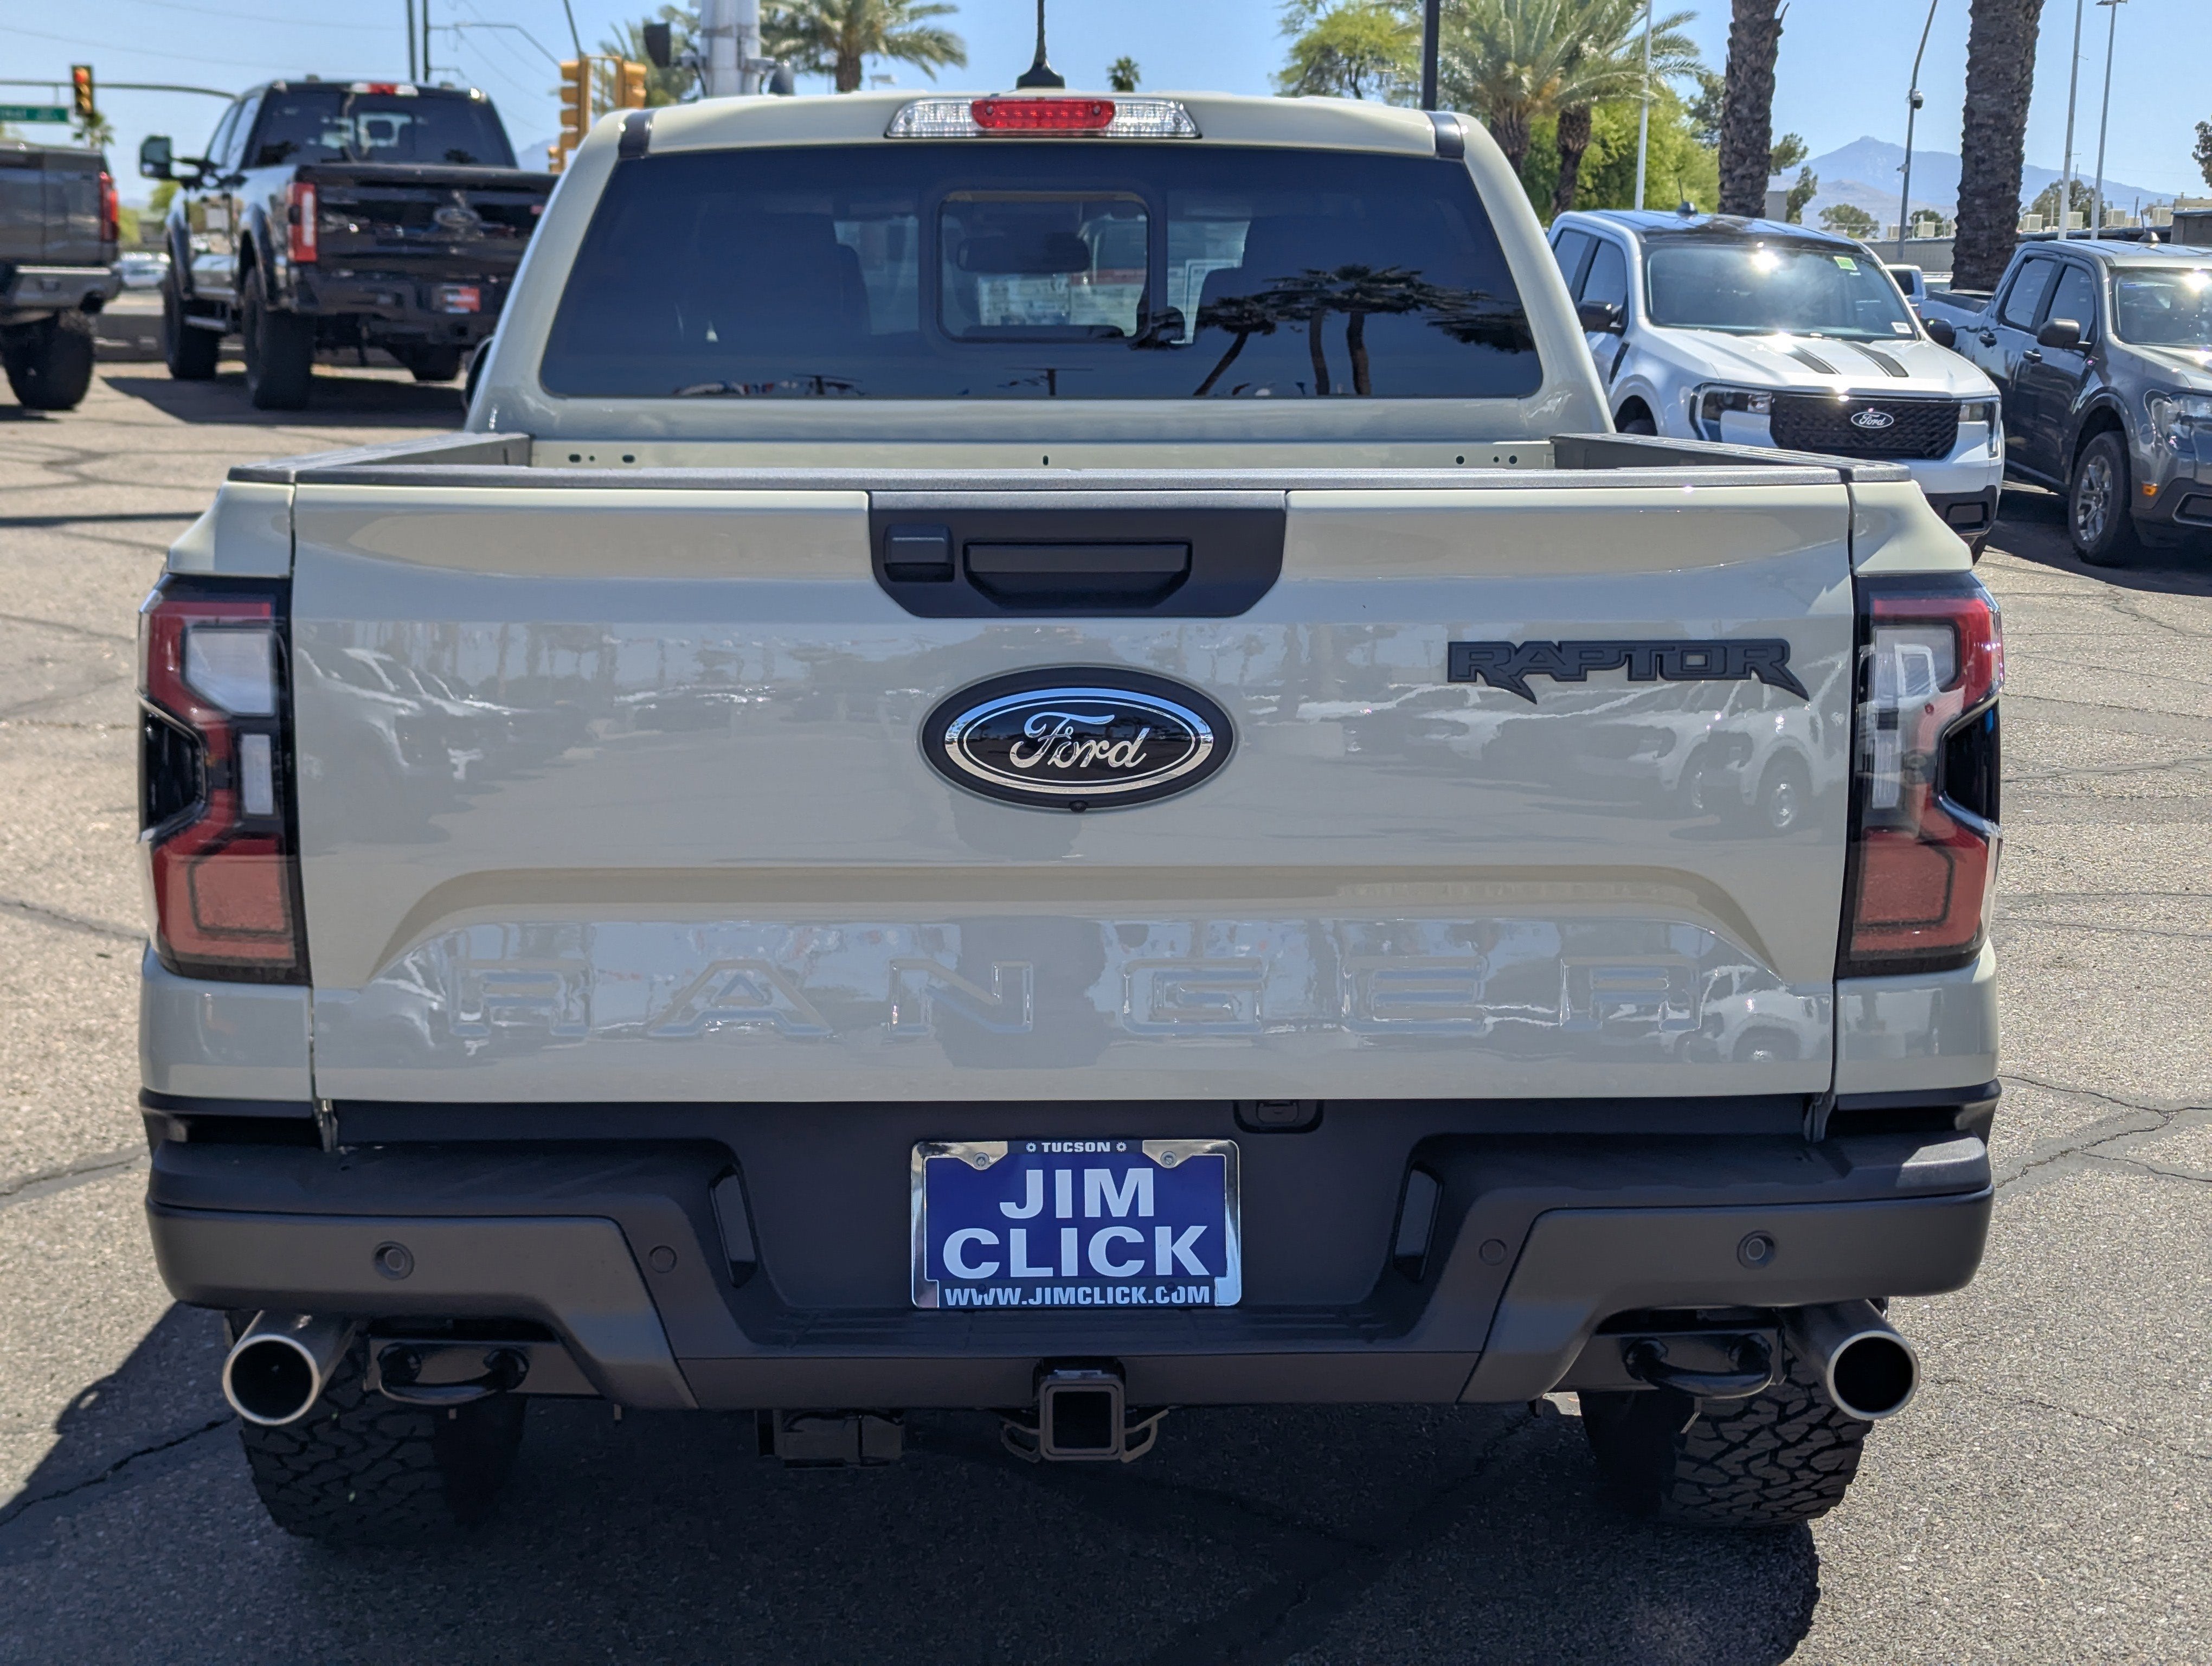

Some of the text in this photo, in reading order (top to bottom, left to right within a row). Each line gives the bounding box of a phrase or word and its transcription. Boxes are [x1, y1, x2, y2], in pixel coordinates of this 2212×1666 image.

[1859, 413, 1886, 426] Ford
[1447, 638, 1810, 705] RAPTOR
[1009, 711, 1150, 768] Ford
[448, 956, 1703, 1036] RANGER
[1041, 1141, 1111, 1153] TUCSON
[999, 1168, 1155, 1219] JIM
[942, 1225, 1210, 1279] CLICK
[944, 1286, 1210, 1306] WWW.JIMCLICK.COM
